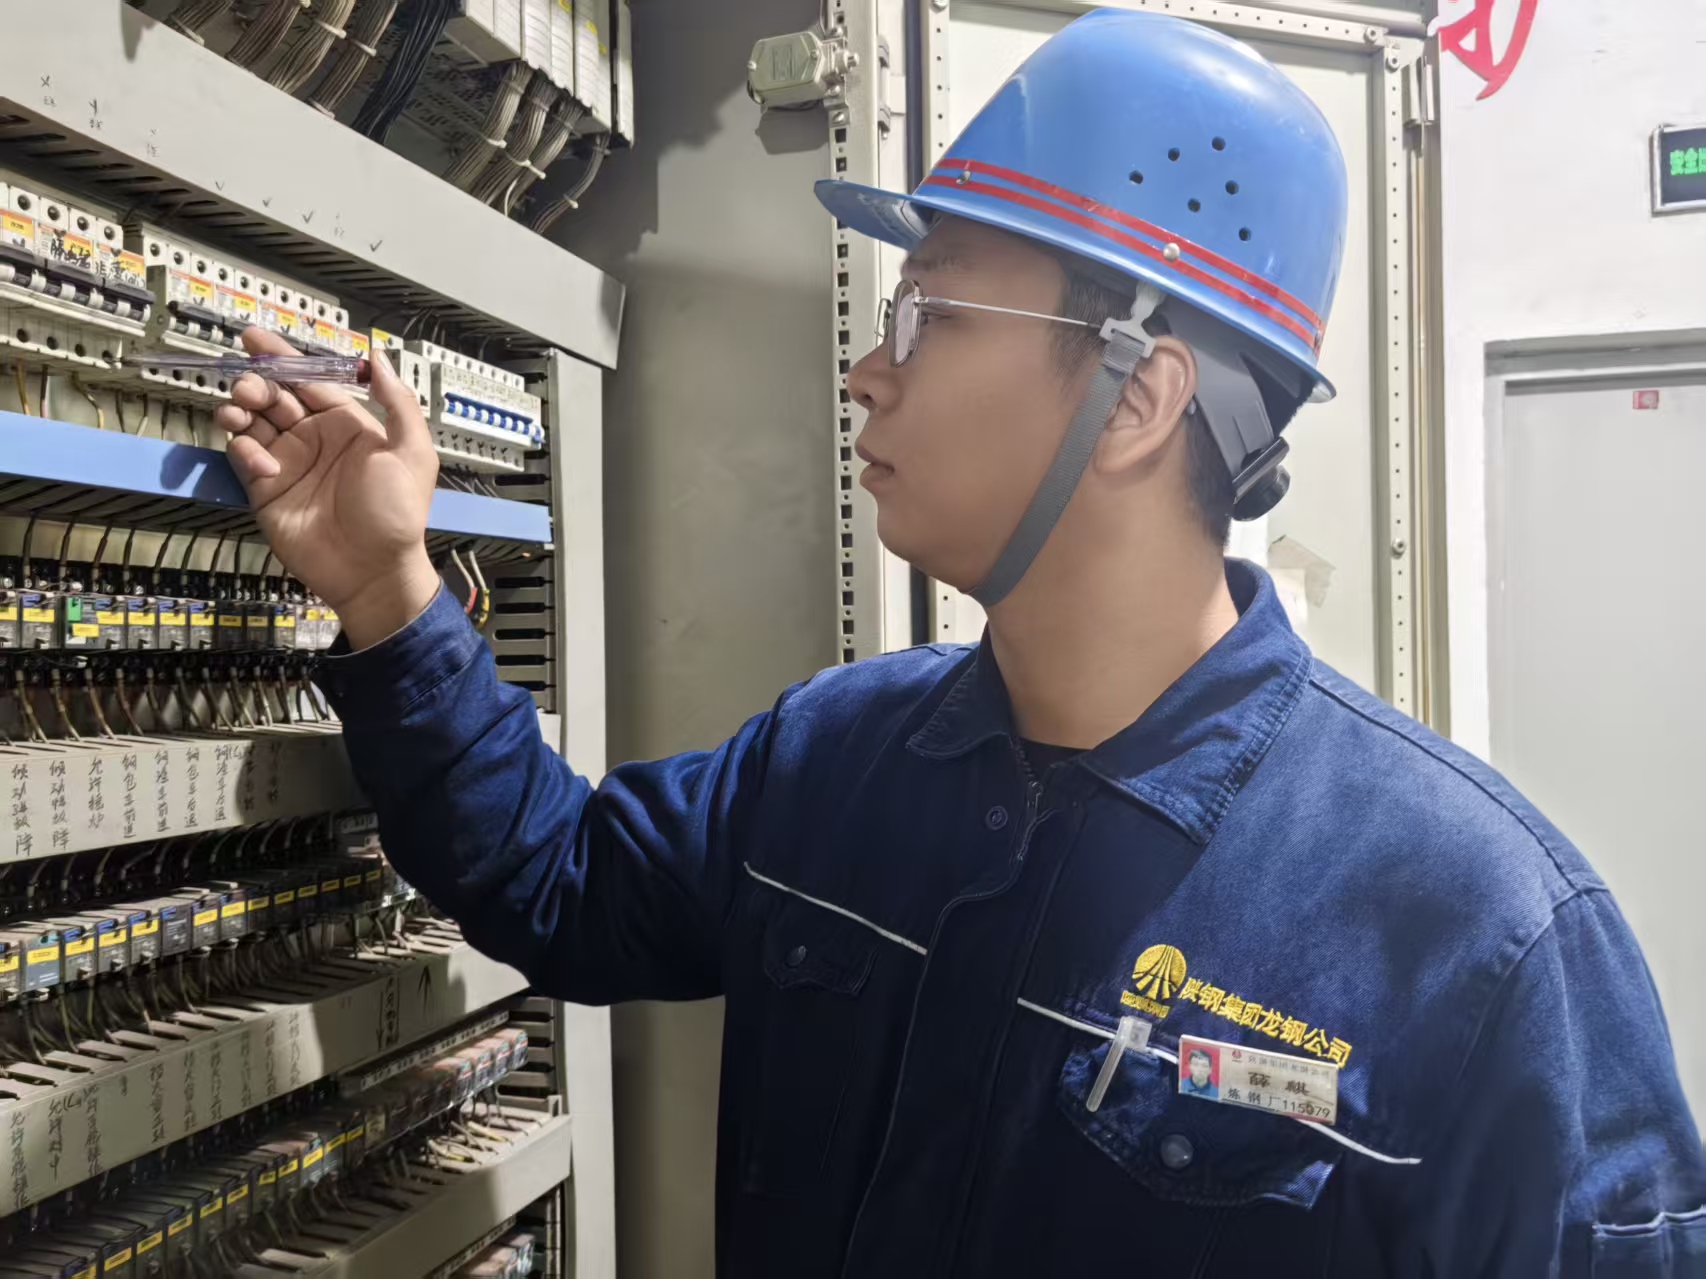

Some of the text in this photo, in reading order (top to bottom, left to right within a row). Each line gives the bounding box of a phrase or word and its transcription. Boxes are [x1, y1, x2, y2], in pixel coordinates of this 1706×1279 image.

[1177, 977, 1353, 1069] 陕钢集团龙钢公司
